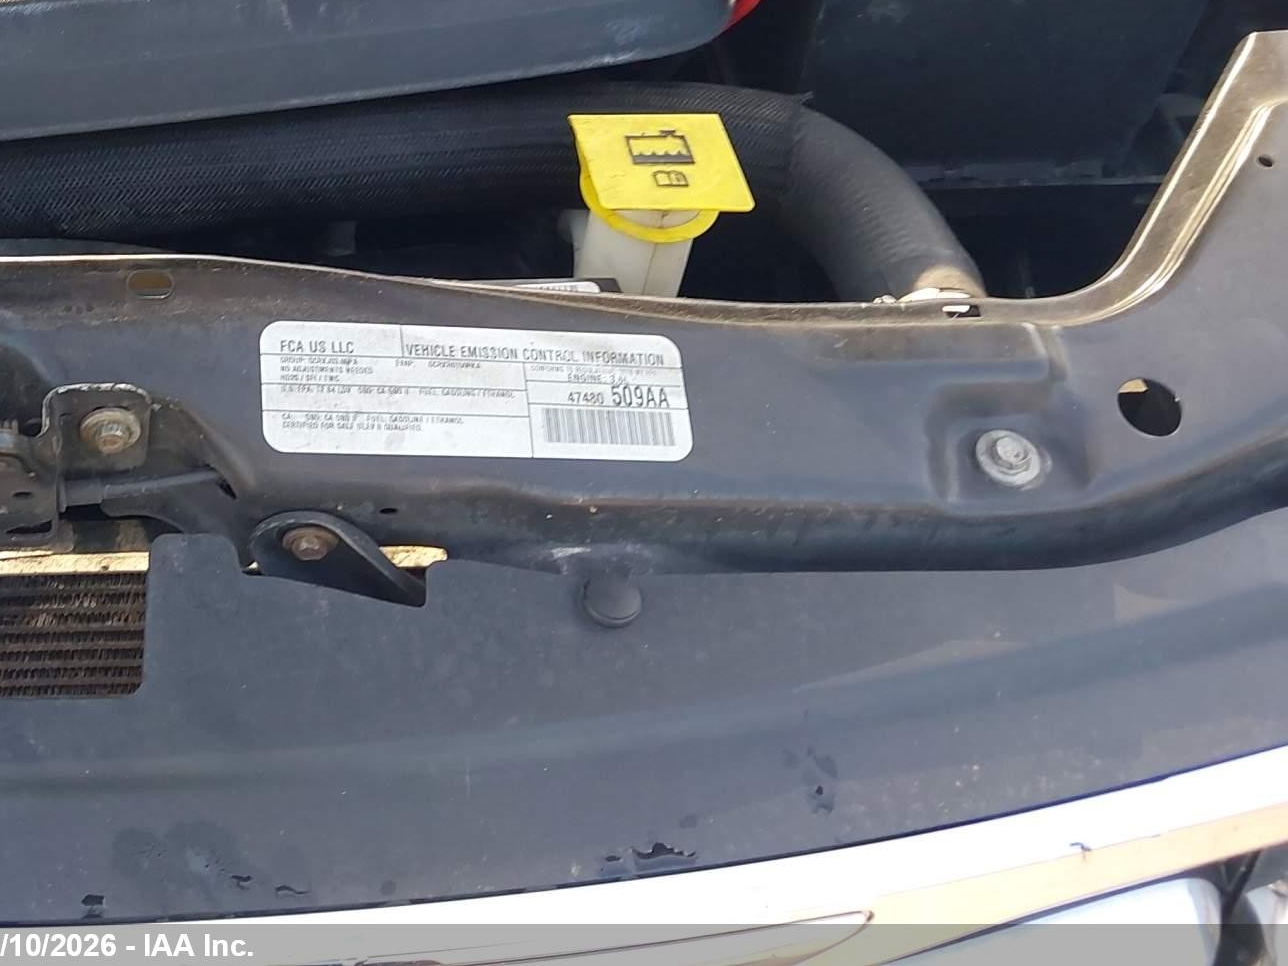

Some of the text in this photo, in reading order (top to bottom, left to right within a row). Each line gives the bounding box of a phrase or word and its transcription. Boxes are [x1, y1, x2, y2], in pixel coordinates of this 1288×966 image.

[280, 340, 354, 354] FCA US LLC
[406, 344, 665, 366] VEHICLE EMISSION CONTROL INFORMATION
[612, 385, 670, 408] 509AA
